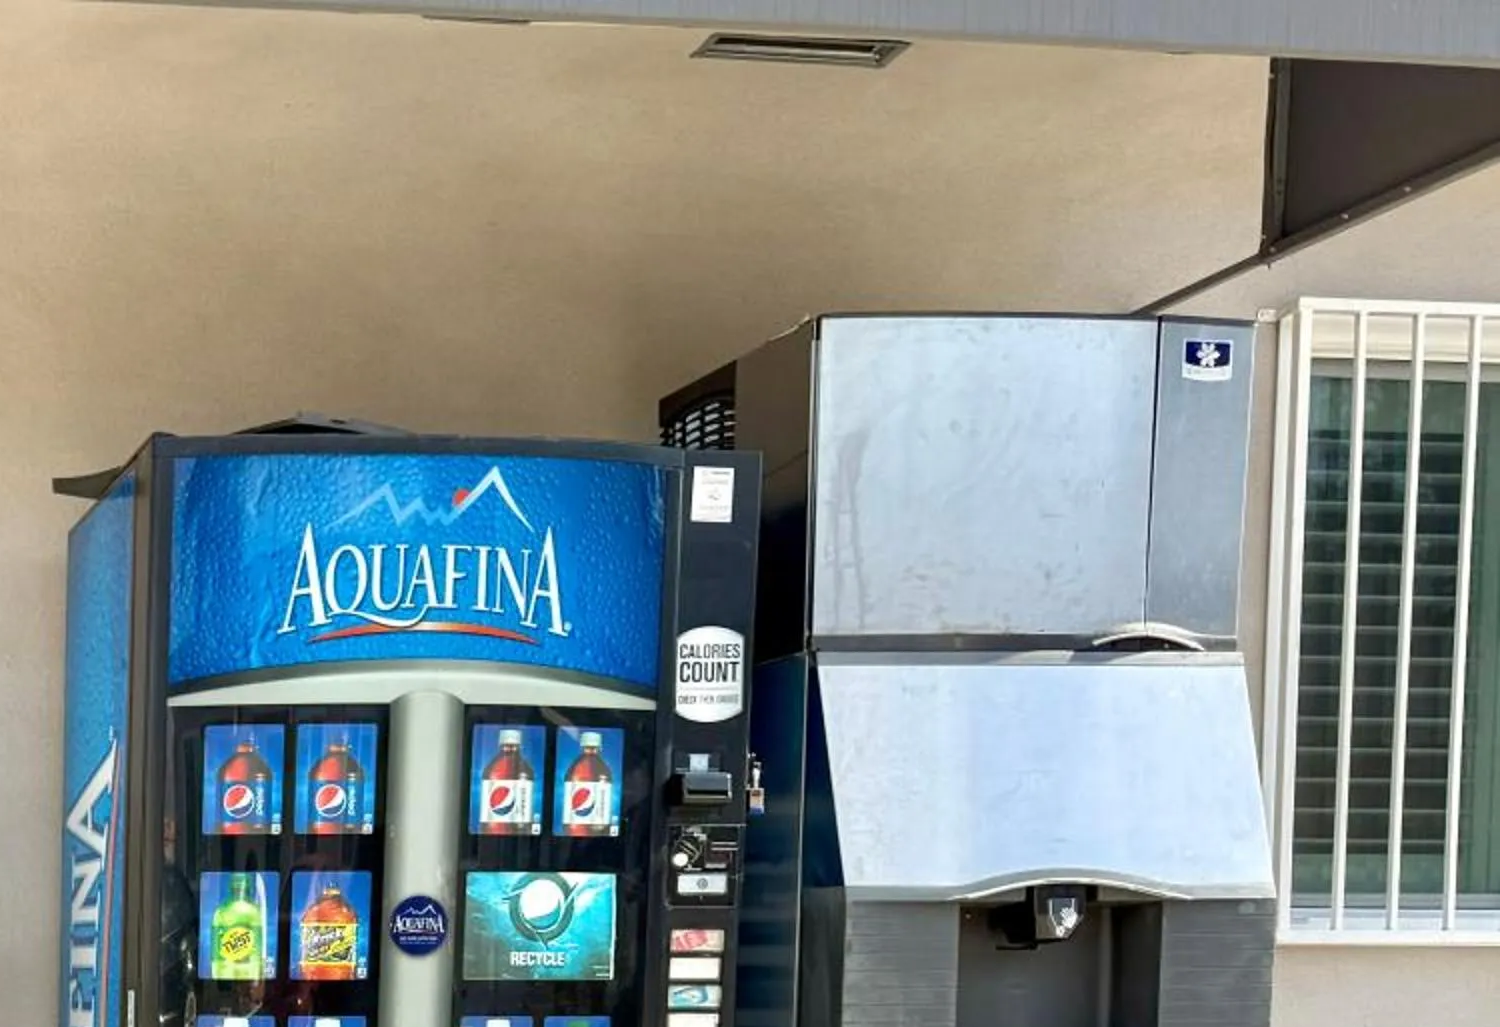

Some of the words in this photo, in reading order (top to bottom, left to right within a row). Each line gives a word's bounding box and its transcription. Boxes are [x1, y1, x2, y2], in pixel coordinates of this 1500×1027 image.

[277, 521, 569, 637] AQUAFINA
[679, 643, 741, 659] CALORIES
[679, 660, 740, 683] COUNT
[510, 951, 565, 967] RECYCLE
